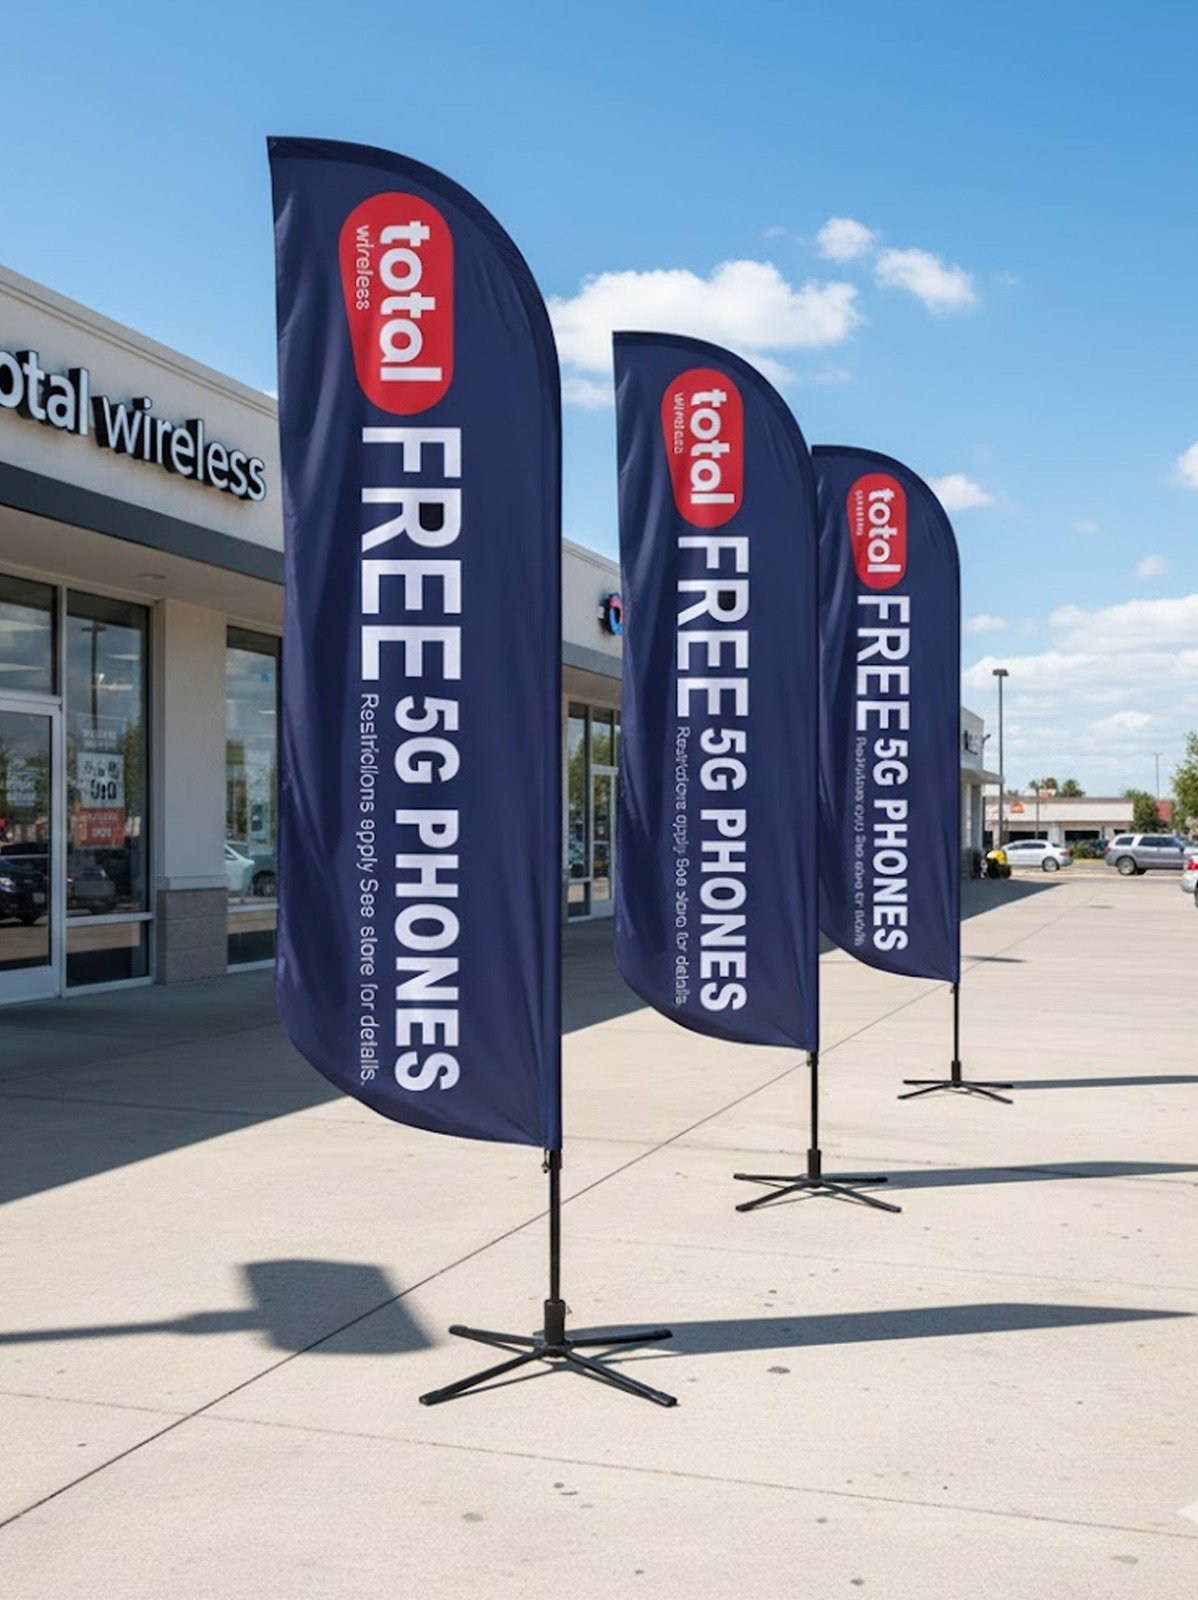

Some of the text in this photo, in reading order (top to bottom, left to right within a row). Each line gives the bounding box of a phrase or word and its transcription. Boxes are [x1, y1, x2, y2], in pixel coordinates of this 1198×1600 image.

[379, 220, 443, 382] total
[93, 395, 266, 501] wireless
[690, 388, 735, 504] total
[857, 595, 910, 731] FREE
[361, 426, 462, 1092] FREE 5G PHONES
[677, 535, 750, 1012] FREE 5G PHONES
[874, 738, 909, 786] 5G
[874, 799, 909, 952] PHONES
[359, 983, 379, 1010] for
